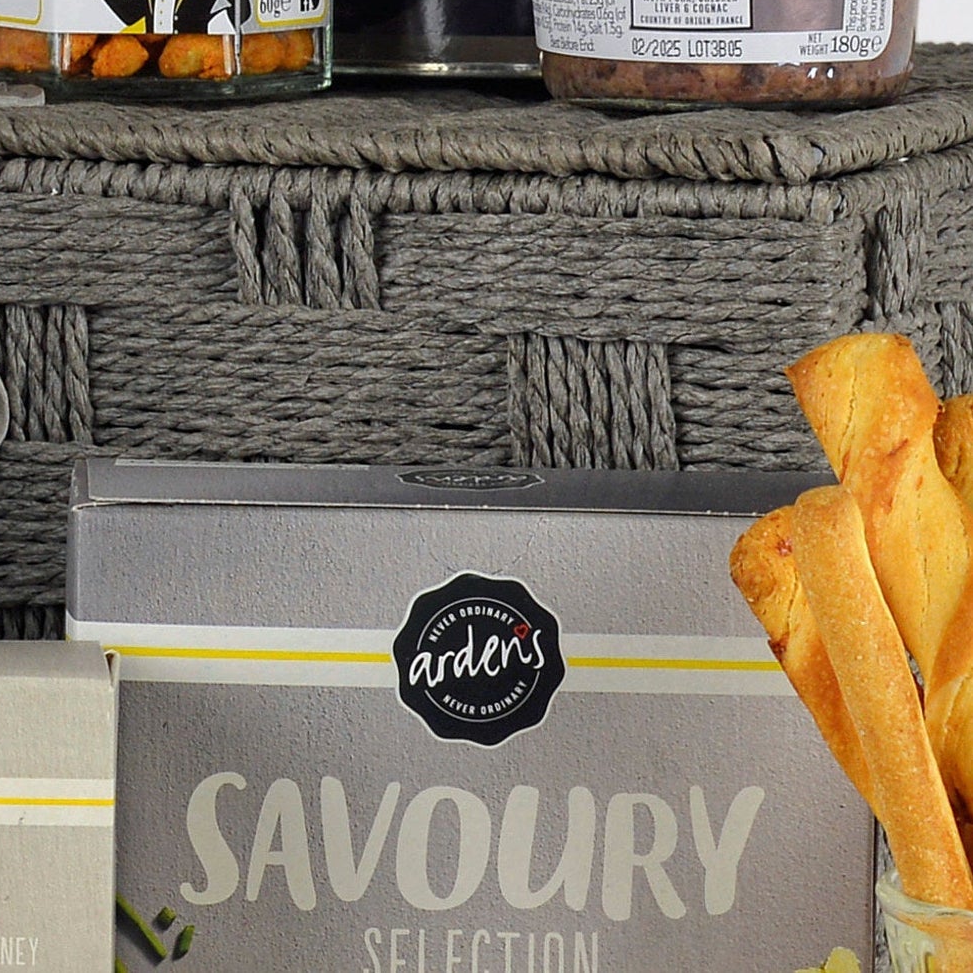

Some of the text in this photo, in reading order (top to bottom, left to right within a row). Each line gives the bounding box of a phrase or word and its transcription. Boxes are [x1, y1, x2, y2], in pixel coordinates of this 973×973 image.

[655, 3, 680, 13] LIVER
[693, 3, 728, 13] COGNAC
[716, 15, 744, 25] FRANCE
[631, 37, 743, 58] 02/2025 LOT3B05
[808, 33, 822, 43] NET
[800, 44, 828, 55] WEIGHT
[428, 605, 515, 643] NEVER ORDINARY
[442, 680, 528, 715] NEVER ORDINARY
[181, 772, 765, 922] SAVOURY
[364, 929, 598, 973] SELECTION
